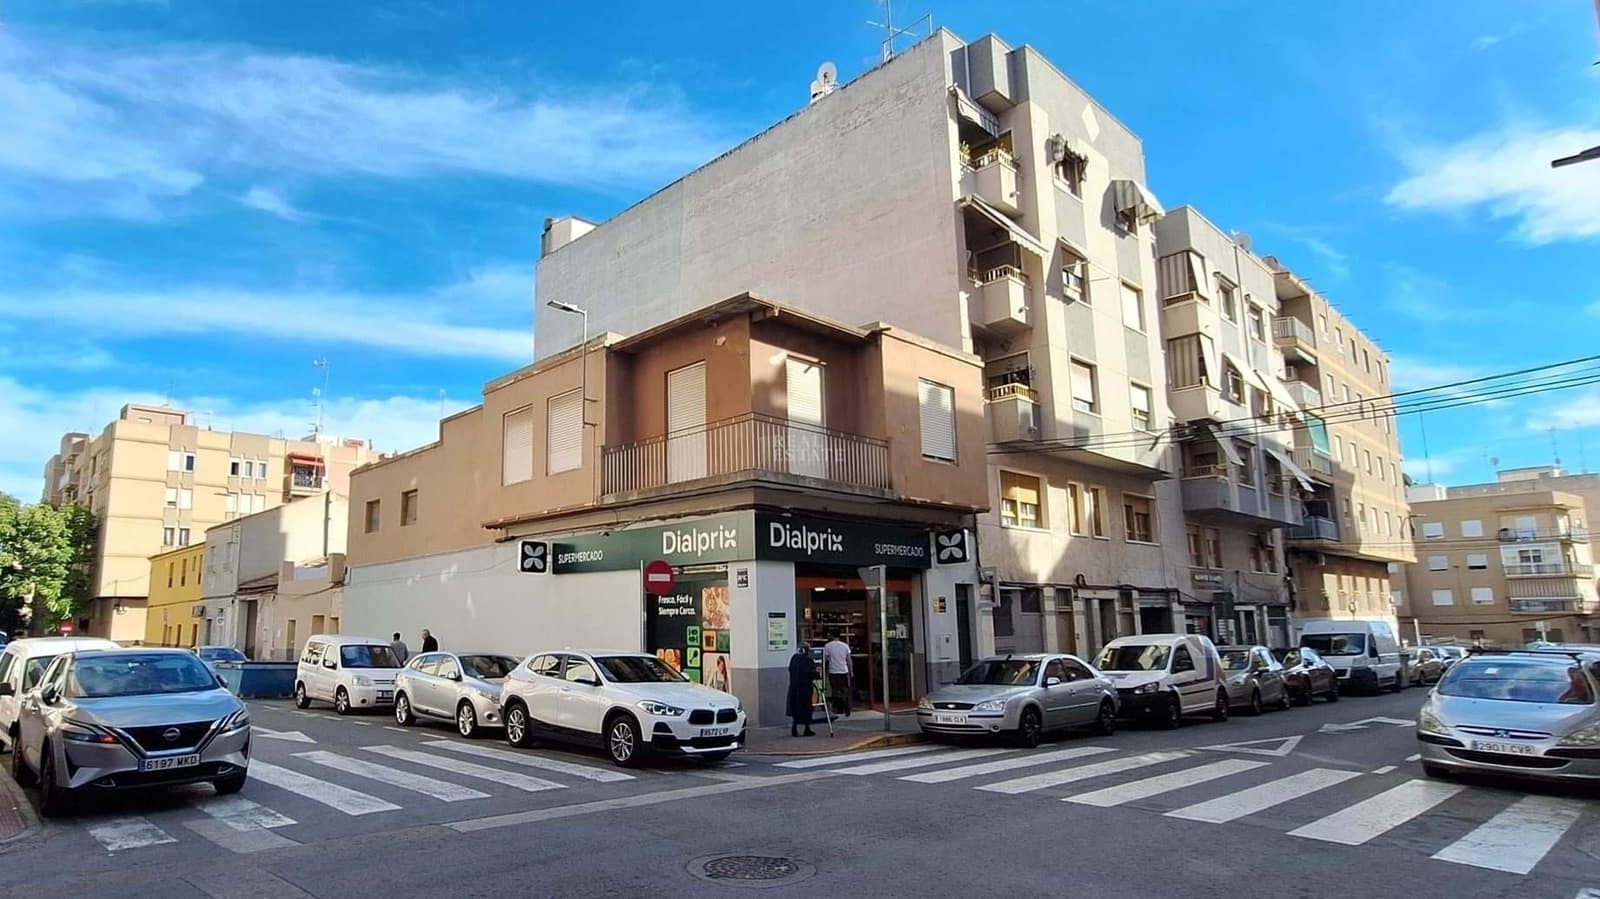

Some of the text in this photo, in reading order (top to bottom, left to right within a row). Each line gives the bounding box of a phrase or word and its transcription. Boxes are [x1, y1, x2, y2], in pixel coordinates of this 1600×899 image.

[663, 525, 737, 557] Dialprix
[769, 521, 843, 555] Dialprix
[558, 550, 603, 564] SUPERMERCADO
[874, 543, 924, 558] SUPERMERCADO
[146, 755, 197, 770] 6197 MKD
